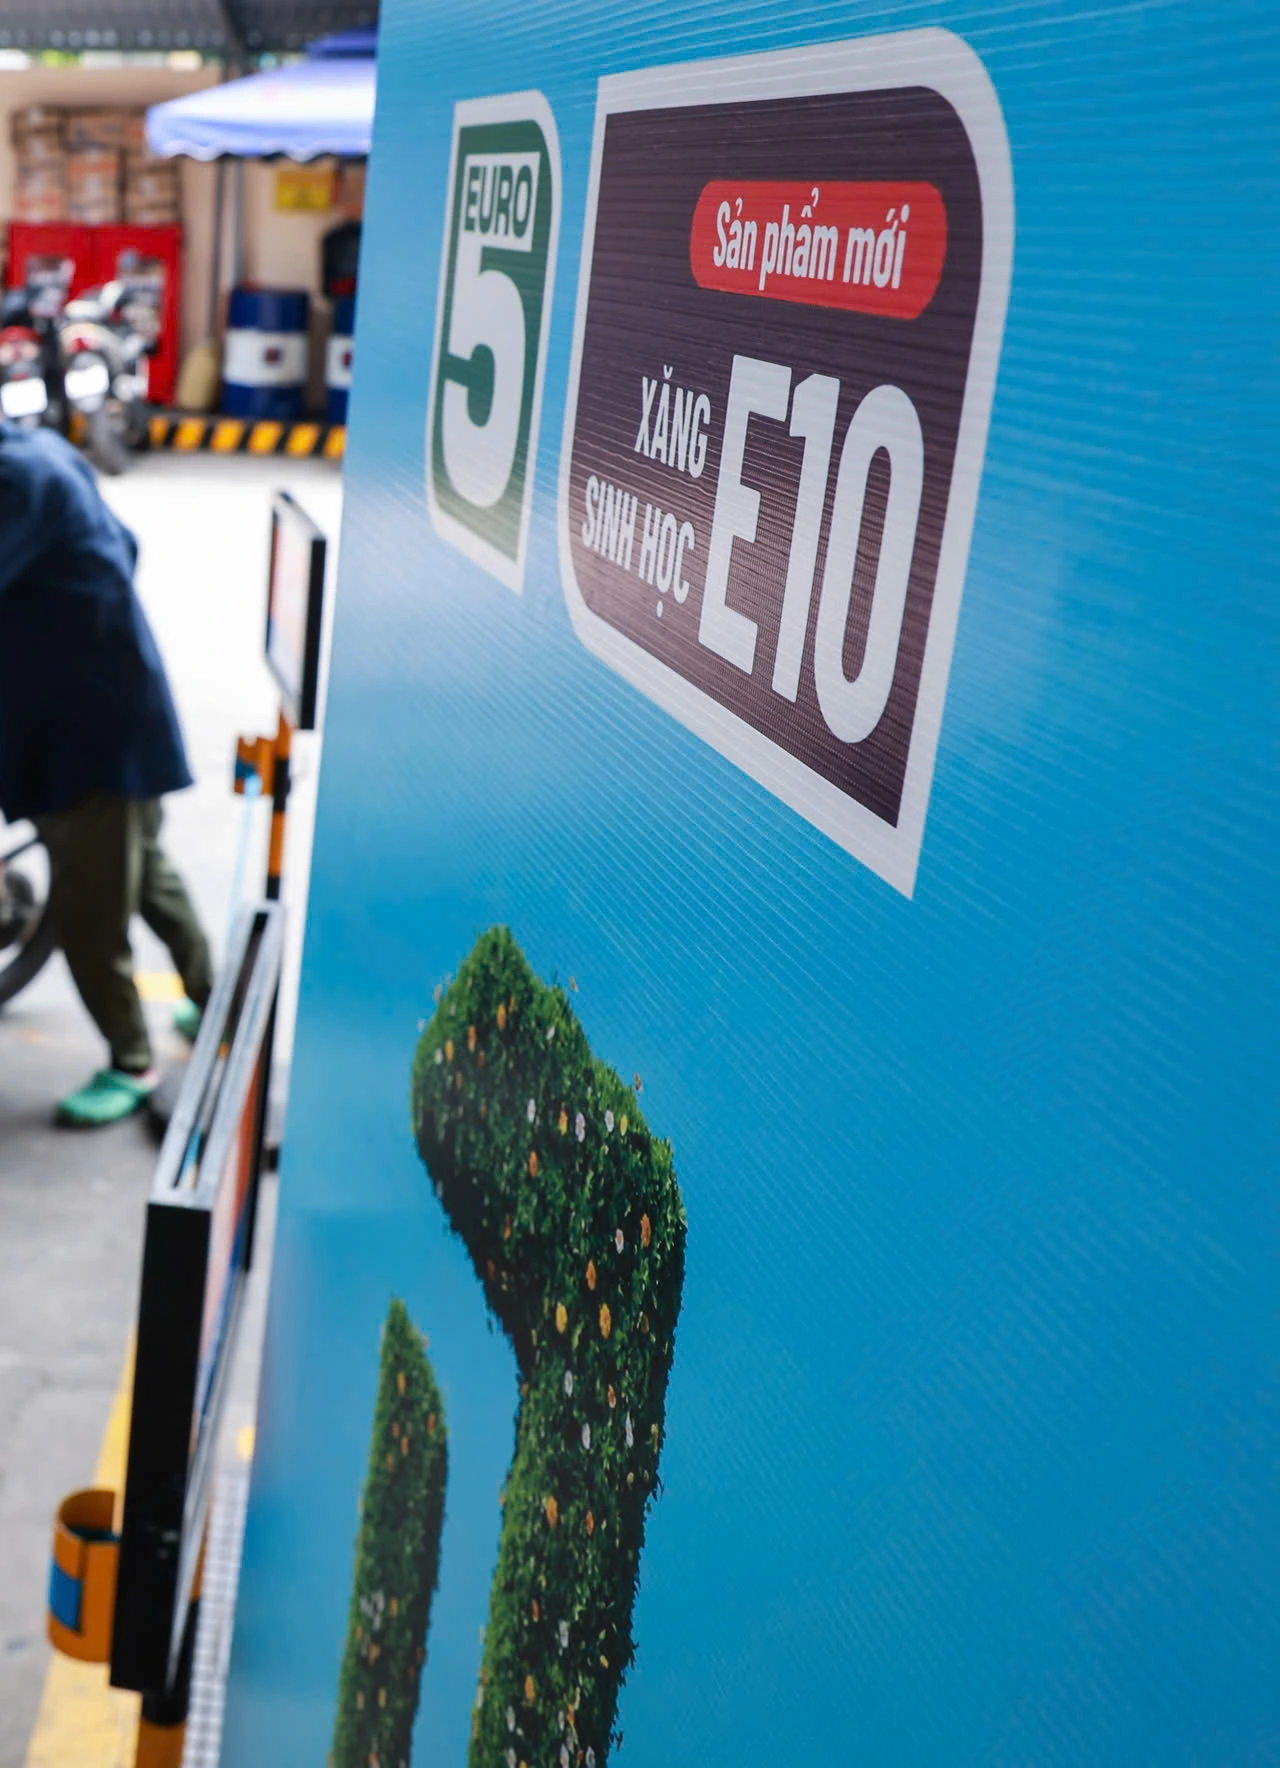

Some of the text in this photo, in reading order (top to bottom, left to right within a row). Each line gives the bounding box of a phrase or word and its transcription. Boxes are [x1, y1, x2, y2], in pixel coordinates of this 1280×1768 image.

[463, 164, 533, 238] EURO
[712, 187, 911, 291] Sản phẩm mới
[442, 238, 532, 508] 5
[633, 364, 712, 479] XĂNG
[581, 474, 696, 618] SINH HỌC
[697, 353, 925, 744] E10
